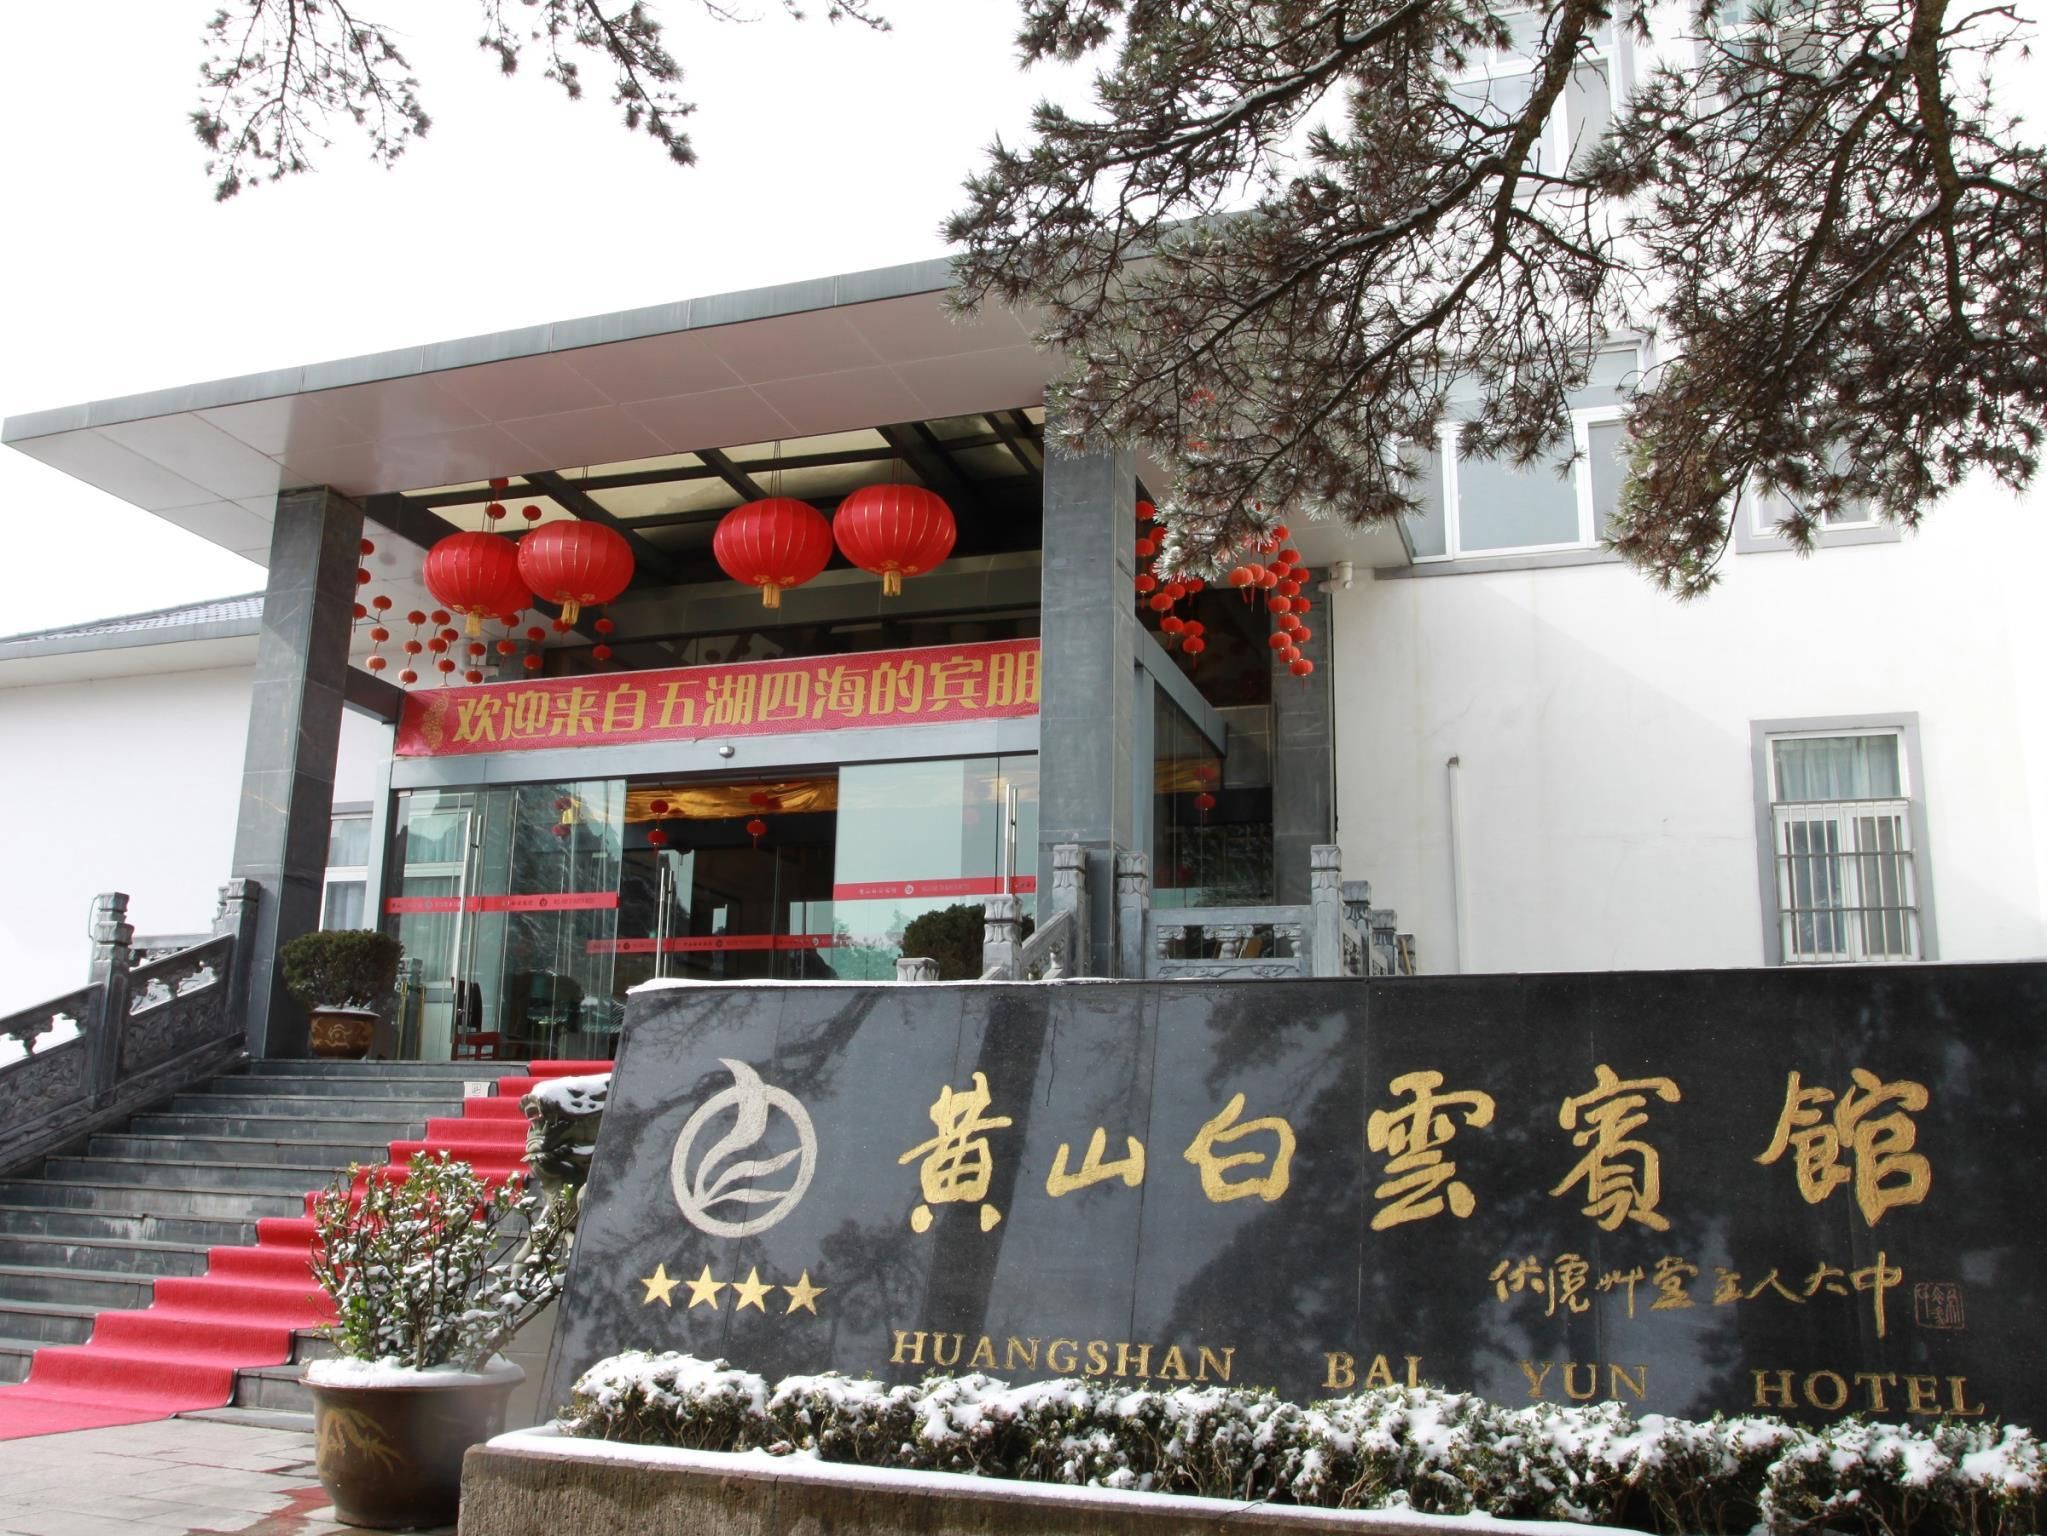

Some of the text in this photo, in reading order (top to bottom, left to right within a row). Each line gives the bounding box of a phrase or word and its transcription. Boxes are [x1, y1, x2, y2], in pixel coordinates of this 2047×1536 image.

[453, 650, 1040, 743] 欢迎来自五湖四海的宾朋
[889, 1329, 1985, 1416] HUANGSHAN BAI YUN HOTEL
